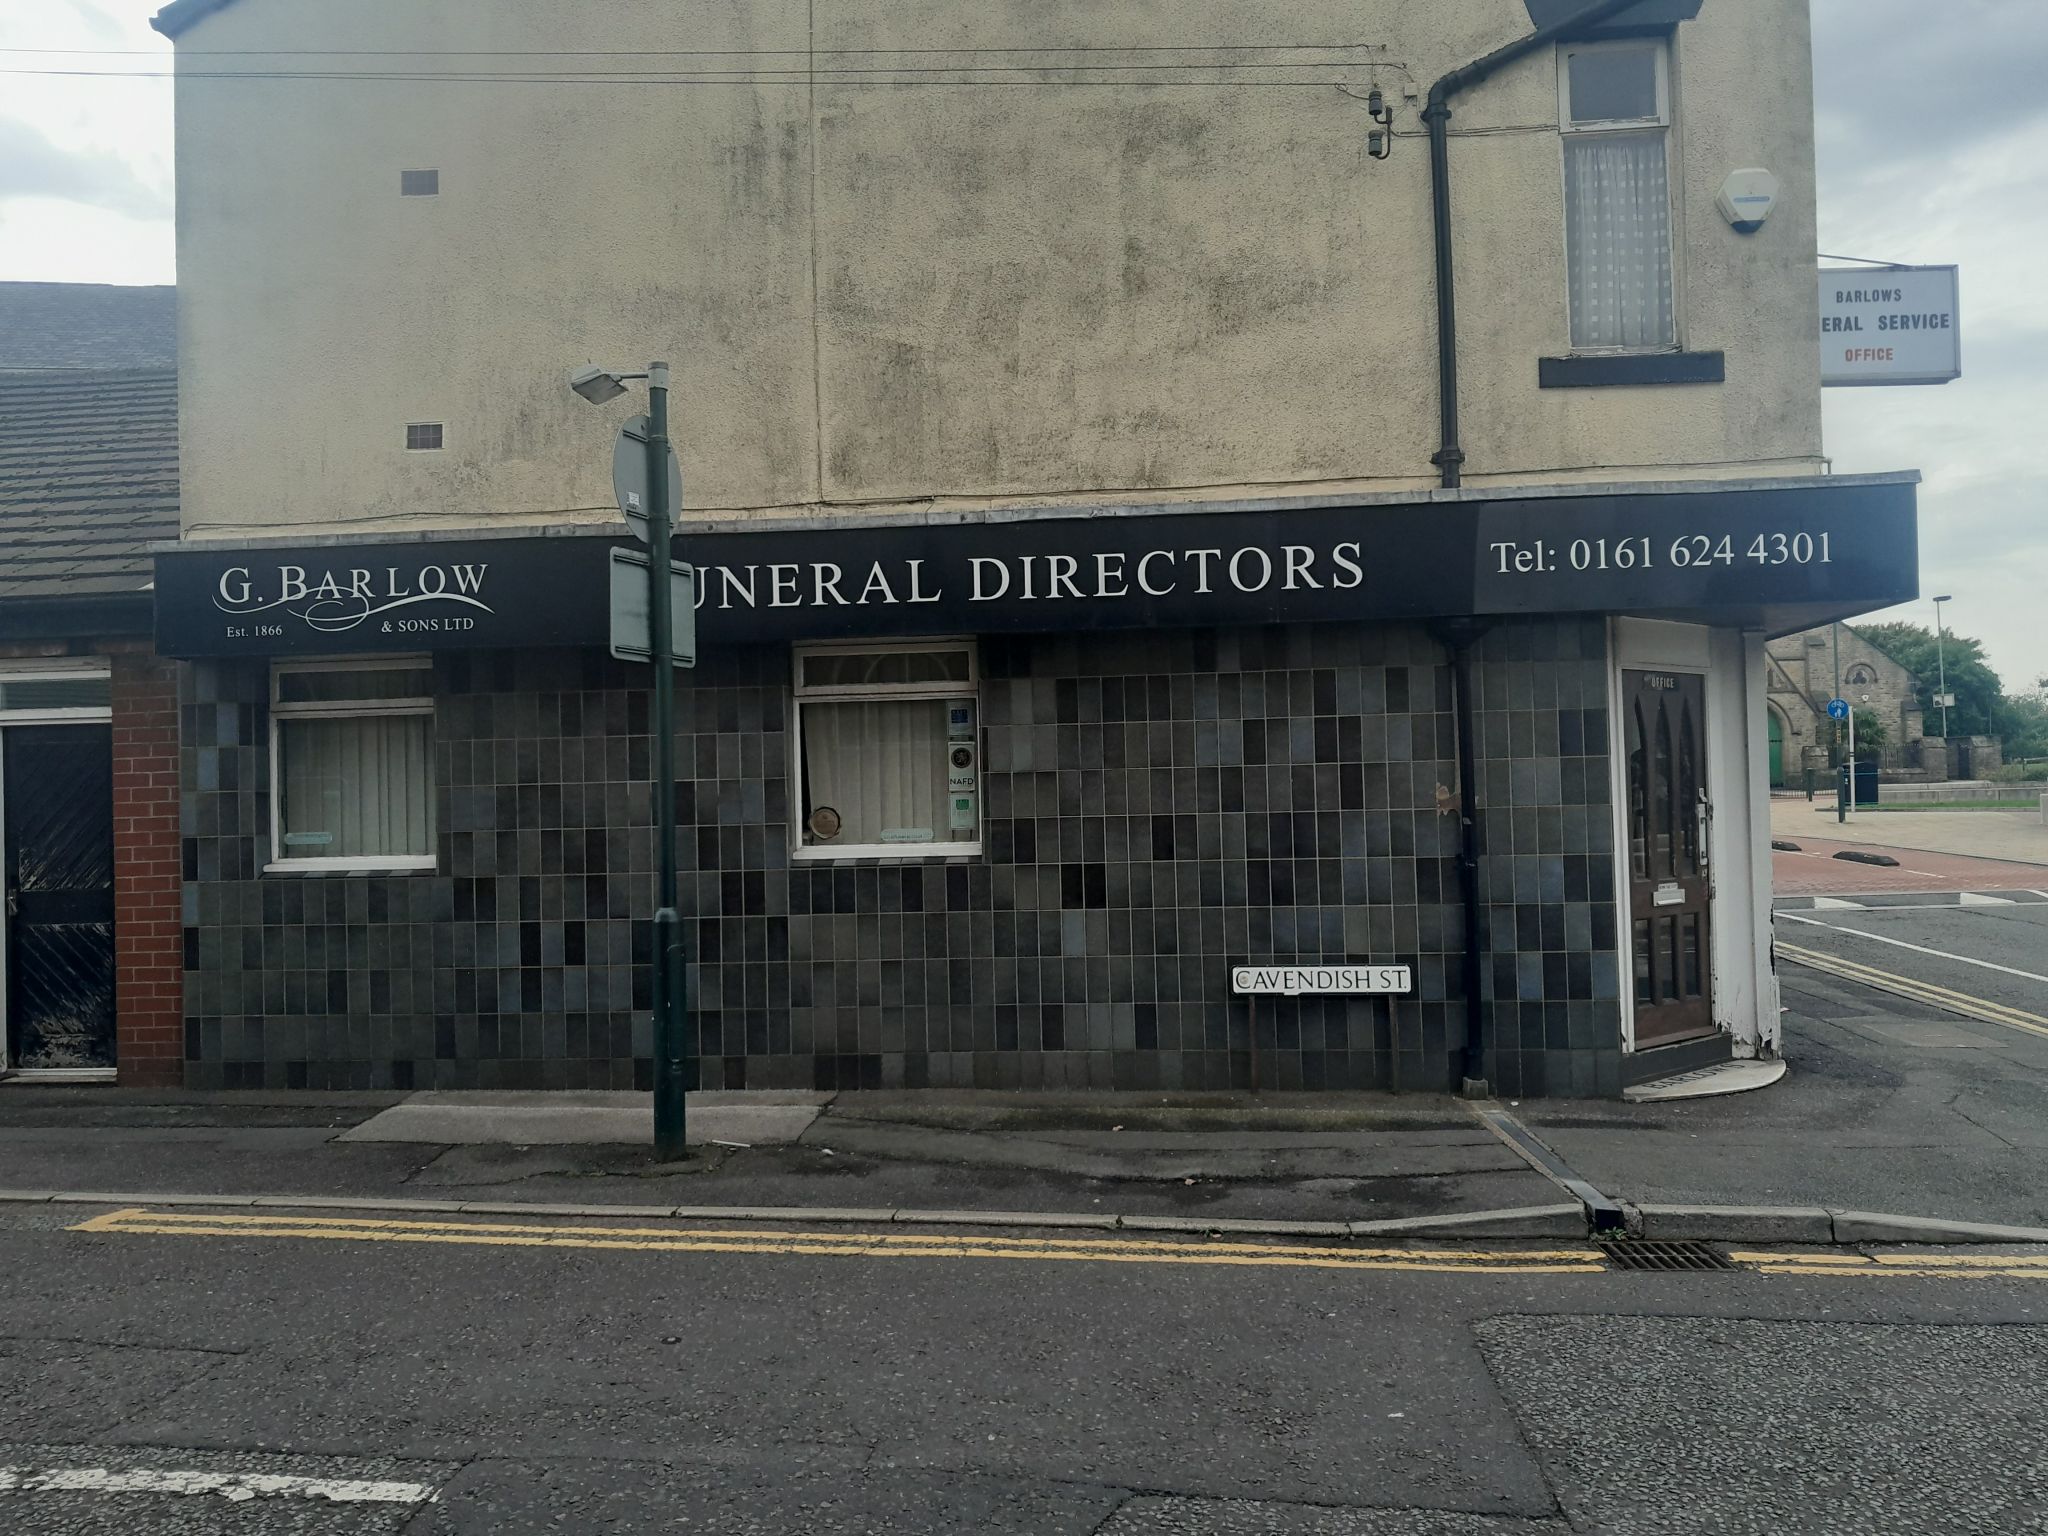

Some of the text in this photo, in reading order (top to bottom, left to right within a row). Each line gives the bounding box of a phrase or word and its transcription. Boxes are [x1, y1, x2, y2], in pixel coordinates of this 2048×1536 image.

[1836, 288, 1902, 303] BARLOWS
[1822, 313, 1950, 332] ERAL SERVICE
[1845, 347, 1894, 362] OFFICE
[1490, 531, 1833, 573] Tel: 0161 624 4301
[219, 563, 488, 603] G. BARLOW
[694, 542, 1363, 609] NERAL DIRECTORS
[226, 624, 283, 638] Est. 1866
[381, 617, 474, 633] & SONS LTD
[950, 777, 974, 786] NAFD
[1236, 970, 1407, 989] CAVENDISH ST.
